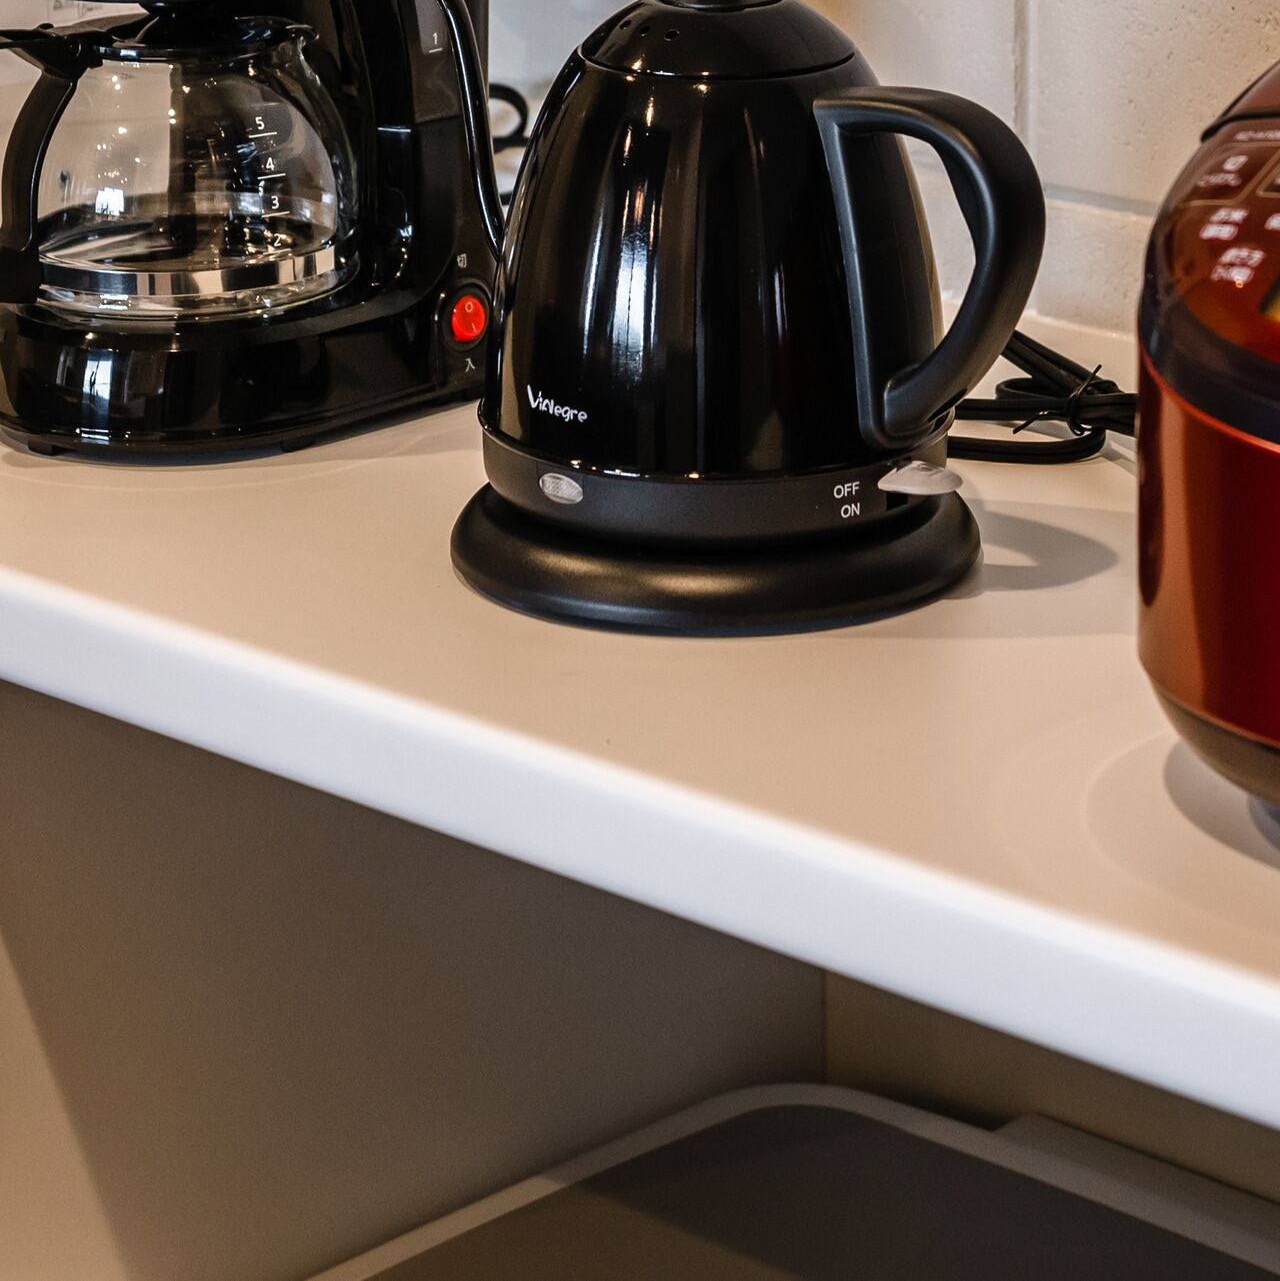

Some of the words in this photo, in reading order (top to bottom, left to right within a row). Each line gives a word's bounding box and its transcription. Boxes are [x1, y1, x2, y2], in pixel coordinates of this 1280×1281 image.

[432, 33, 439, 45] 1
[255, 116, 265, 130] 5
[265, 157, 275, 171] 4
[271, 195, 280, 210] 3
[465, 357, 476, 373] 入
[833, 480, 861, 499] OFF
[840, 502, 860, 519] ON
